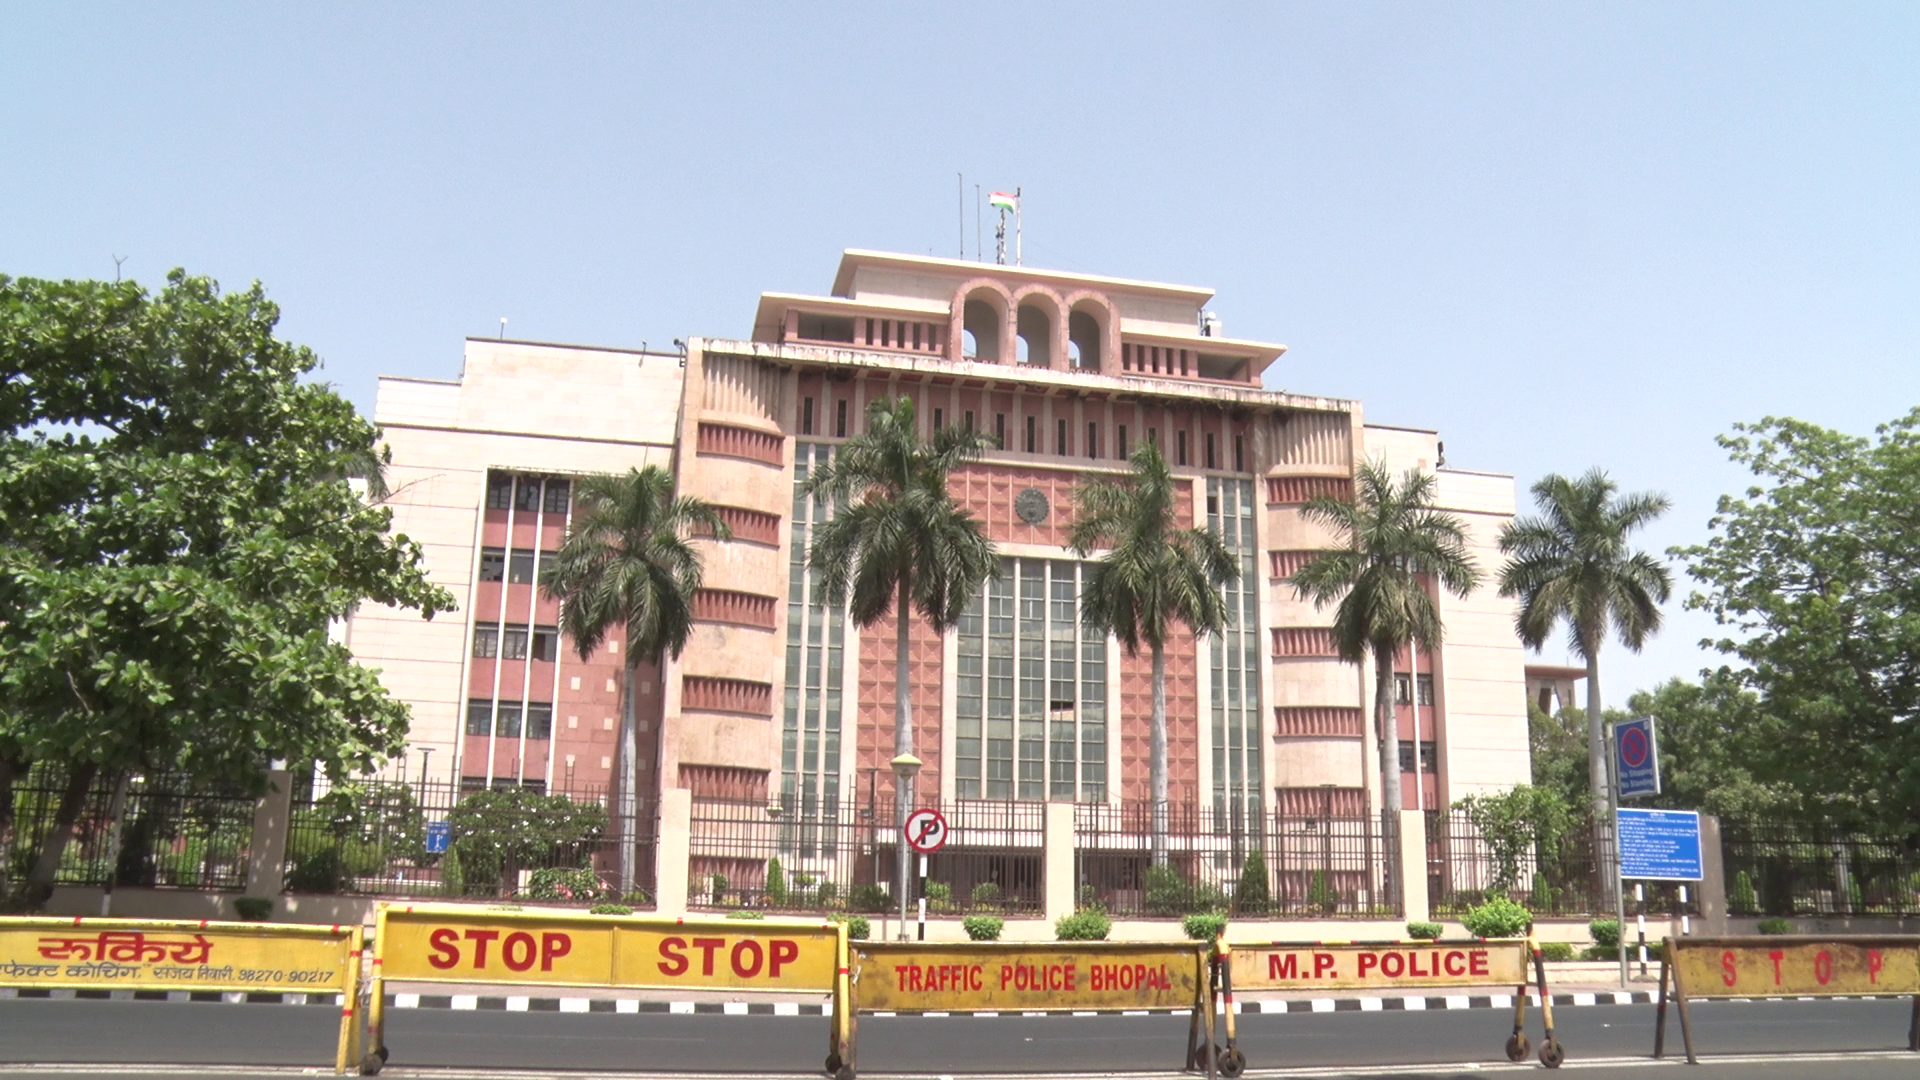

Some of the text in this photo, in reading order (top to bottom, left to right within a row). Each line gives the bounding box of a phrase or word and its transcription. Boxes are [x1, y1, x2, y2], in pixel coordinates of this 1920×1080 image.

[428, 928, 572, 972] STOP
[657, 937, 799, 978] STOP
[1268, 951, 1489, 980] M.P. POLICE
[1722, 950, 1883, 987] STOP
[896, 964, 983, 992] TRAFFIC
[1001, 964, 1076, 992] POLICE
